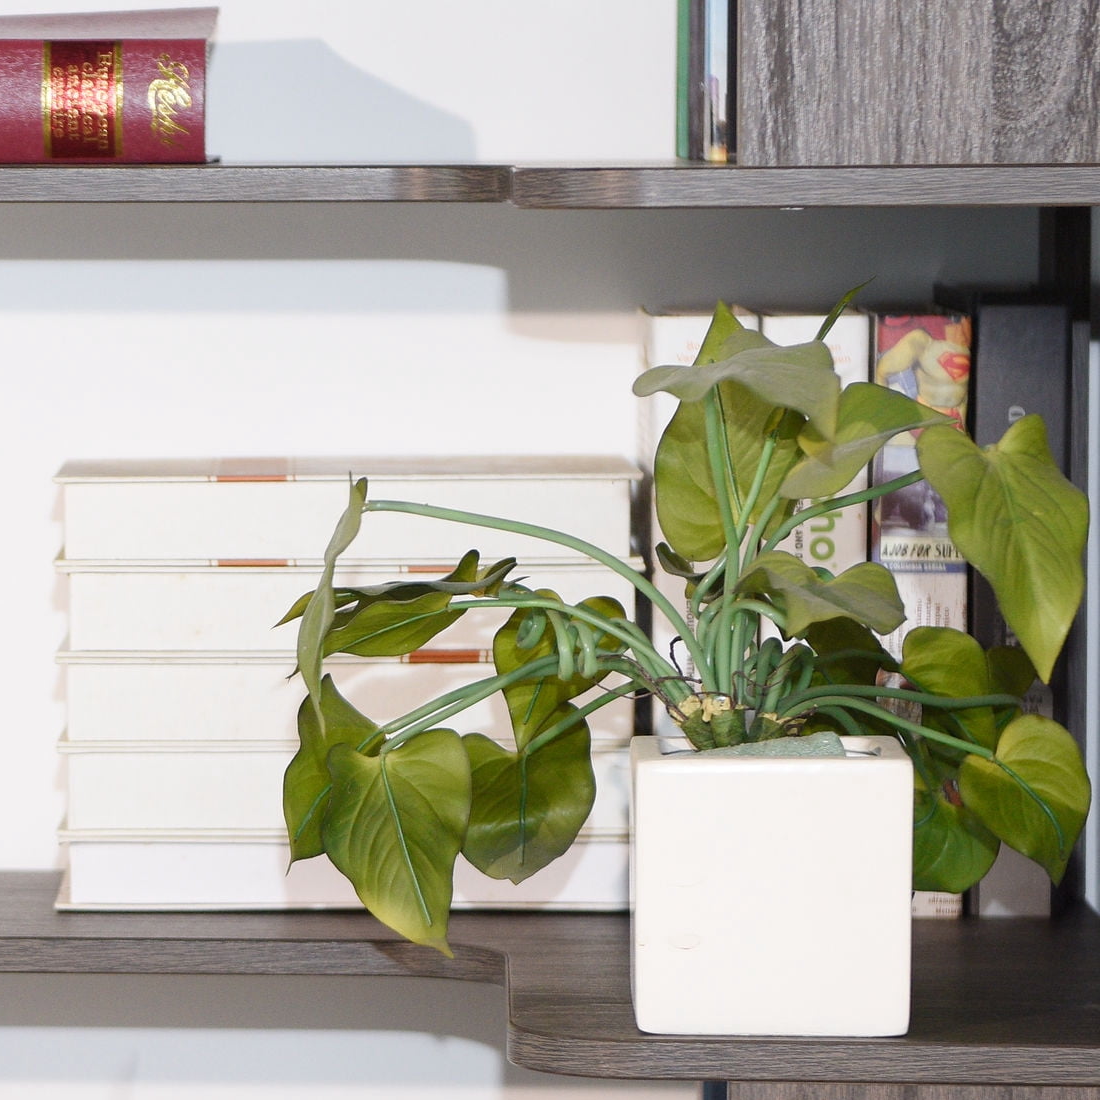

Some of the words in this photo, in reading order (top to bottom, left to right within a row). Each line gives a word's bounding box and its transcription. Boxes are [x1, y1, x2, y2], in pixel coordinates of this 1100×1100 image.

[889, 543, 909, 557] JOB
[910, 543, 932, 558] FOR
[934, 543, 965, 559] SUP
